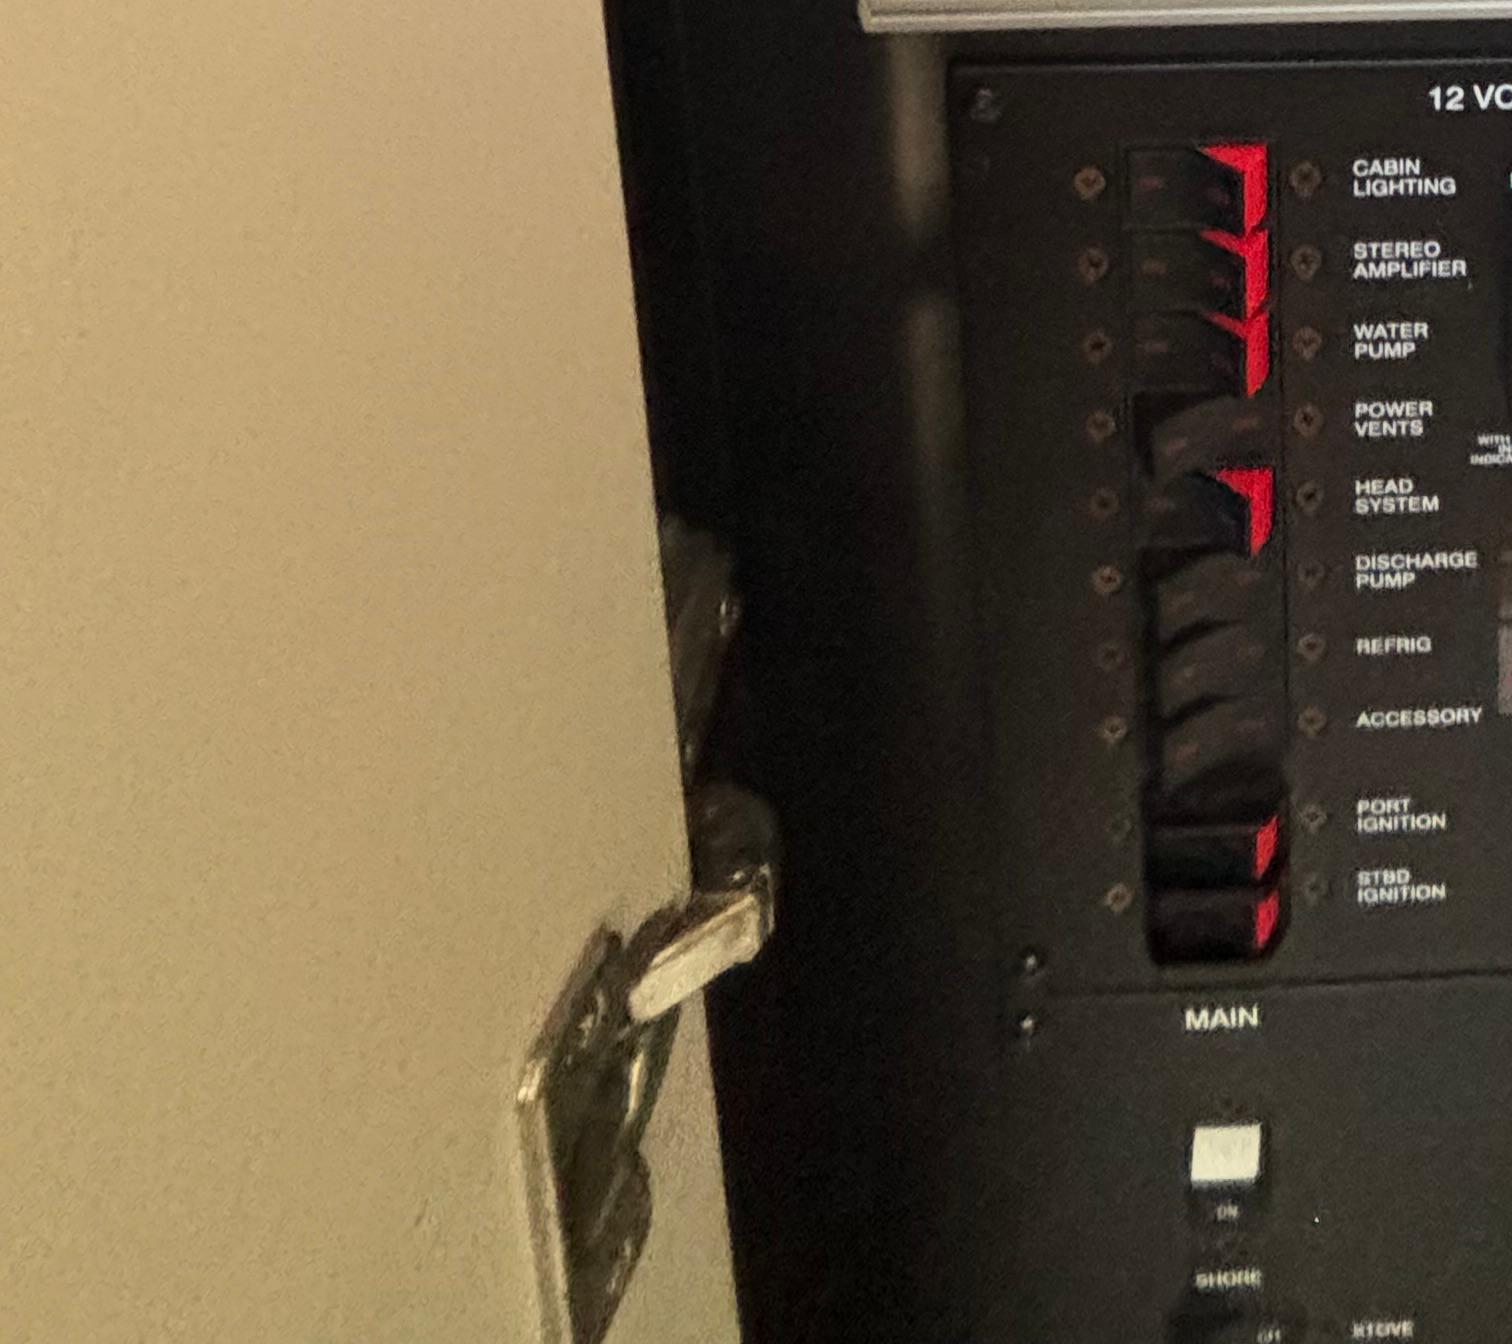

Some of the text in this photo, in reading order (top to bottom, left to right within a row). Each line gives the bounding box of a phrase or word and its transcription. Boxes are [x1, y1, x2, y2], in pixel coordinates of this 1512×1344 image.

[1429, 85, 1464, 111] 12
[1353, 158, 1420, 177] CABIN
[1353, 177, 1457, 197] LIGHTING
[1353, 240, 1441, 260] STEREO
[1353, 259, 1467, 280] AMPLIFIER
[1354, 321, 1429, 340] WATER
[1354, 341, 1416, 360] PUMP
[1354, 400, 1434, 419] POWER
[1354, 419, 1424, 438] VENTS
[1355, 477, 1414, 496] HEAD
[1355, 494, 1440, 514] SYSTEM
[1356, 549, 1478, 571] DISCHARGE
[1356, 570, 1417, 591] PUMP
[1356, 635, 1432, 656] REFRIG
[1355, 707, 1482, 728] ACCESSORY
[1358, 797, 1412, 814] PORT
[1357, 813, 1447, 834] IGNITION
[1358, 867, 1411, 886] STBD
[1357, 884, 1447, 904] IGNITION
[1184, 1003, 1261, 1031] MAIN
[1195, 1269, 1262, 1289] SHORE
